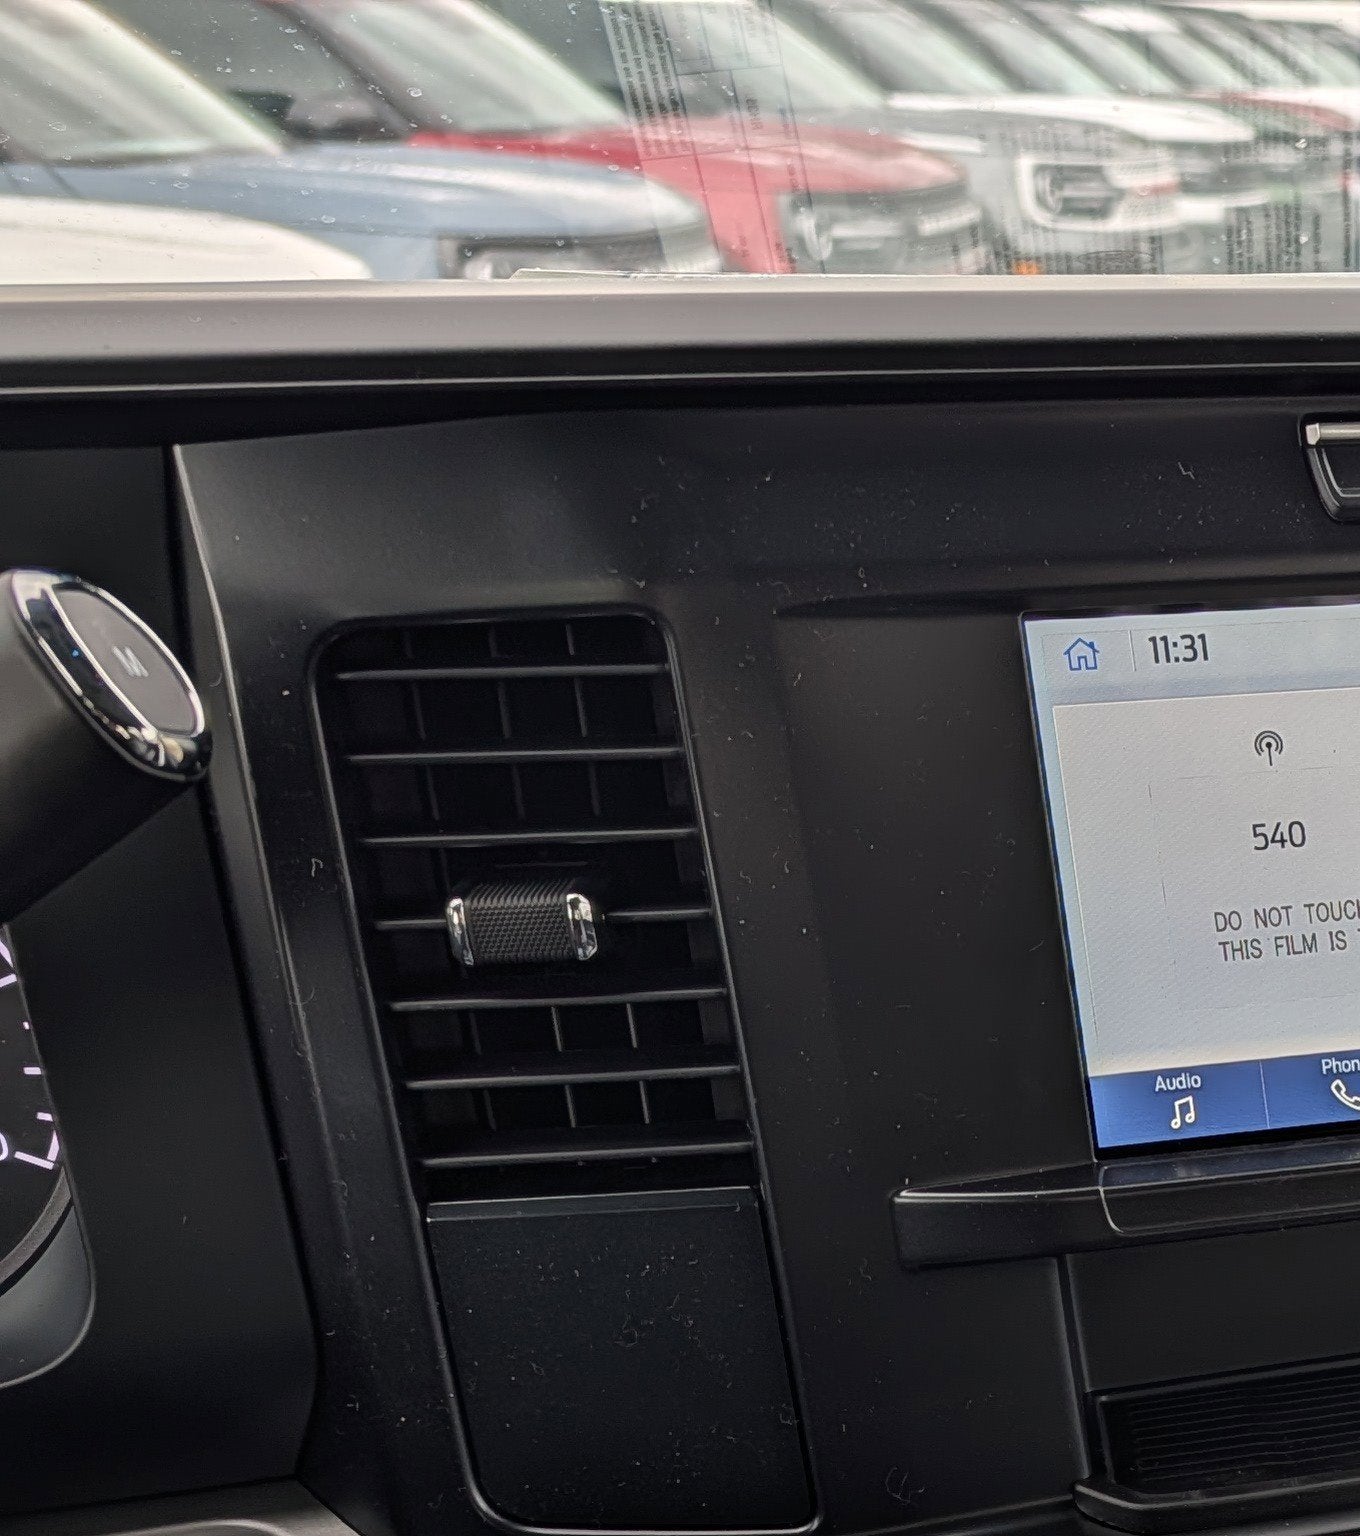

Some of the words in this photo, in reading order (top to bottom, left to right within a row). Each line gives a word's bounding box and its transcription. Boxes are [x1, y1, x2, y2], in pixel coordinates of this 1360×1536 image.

[1147, 633, 1210, 667] 11:31
[1251, 820, 1306, 851] 540
[1214, 910, 1242, 933] DO
[1254, 905, 1293, 929] NOT
[1218, 939, 1263, 963] THIS
[1274, 933, 1318, 958] FILM
[1329, 930, 1347, 951] IS
[1155, 1073, 1201, 1092] Audio
